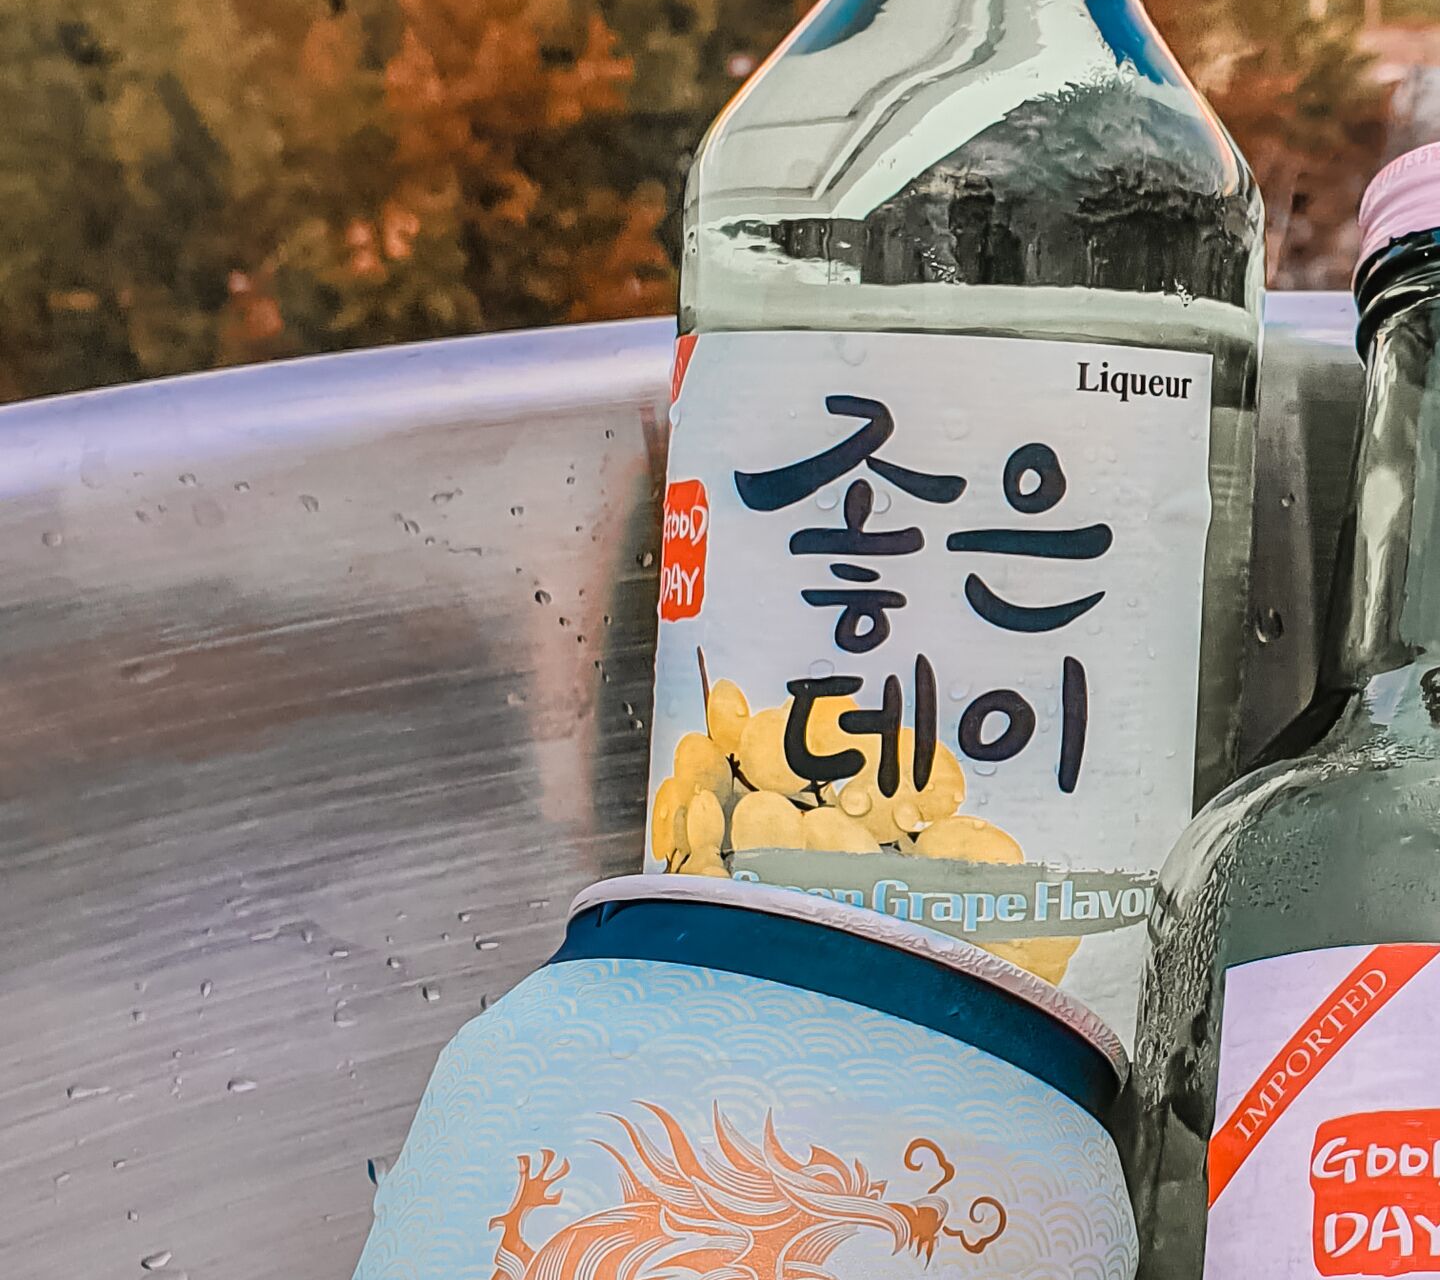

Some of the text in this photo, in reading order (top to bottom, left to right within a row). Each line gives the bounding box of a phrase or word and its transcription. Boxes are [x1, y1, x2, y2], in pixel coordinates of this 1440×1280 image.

[1076, 361, 1193, 403] Liqueur
[734, 394, 1114, 654] 좋은
[782, 652, 1089, 799] 데이
[872, 878, 1027, 933] Grape
[1232, 966, 1390, 1142] IMPORTED
